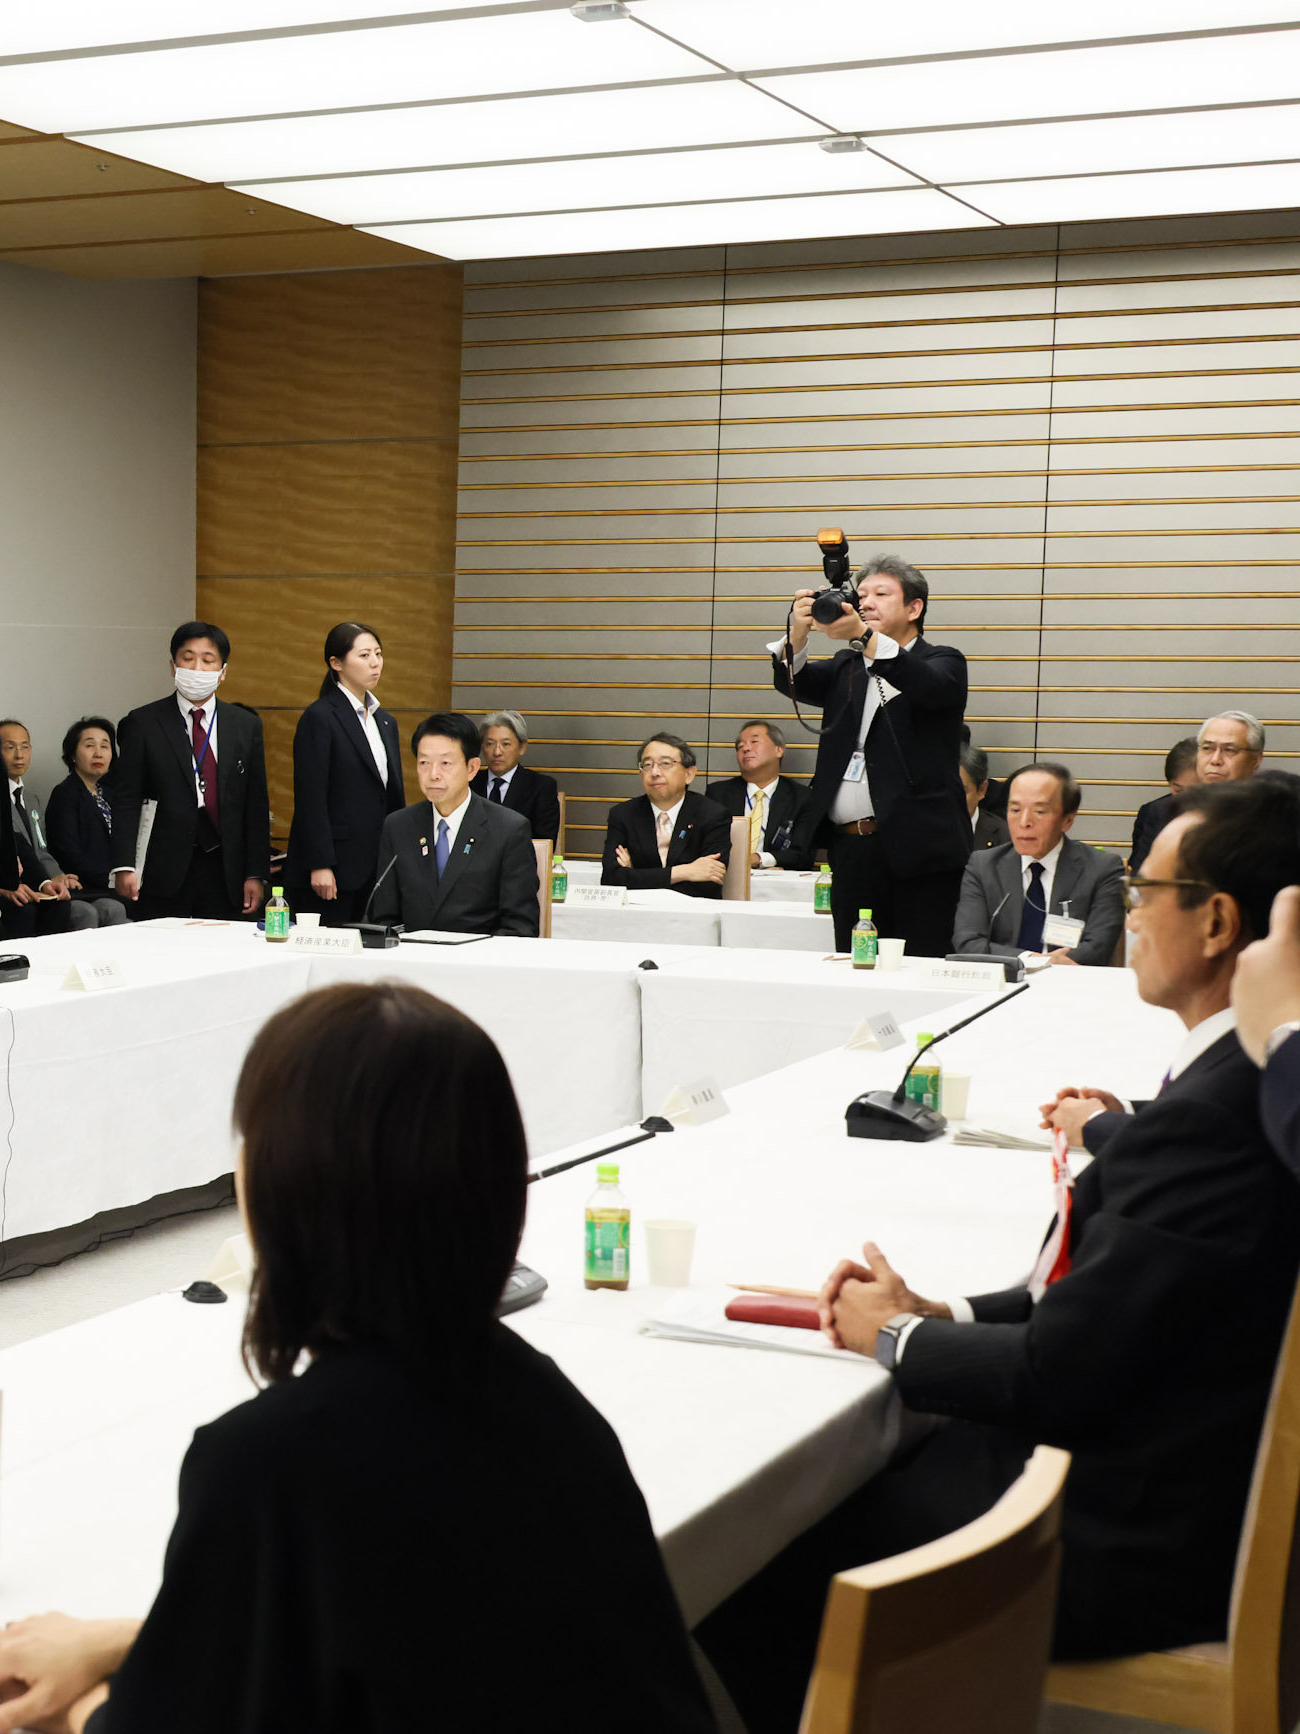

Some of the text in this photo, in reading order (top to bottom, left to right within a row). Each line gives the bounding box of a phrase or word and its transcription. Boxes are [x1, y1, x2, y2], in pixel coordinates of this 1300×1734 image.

[295, 935, 351, 948] 経済産業大臣
